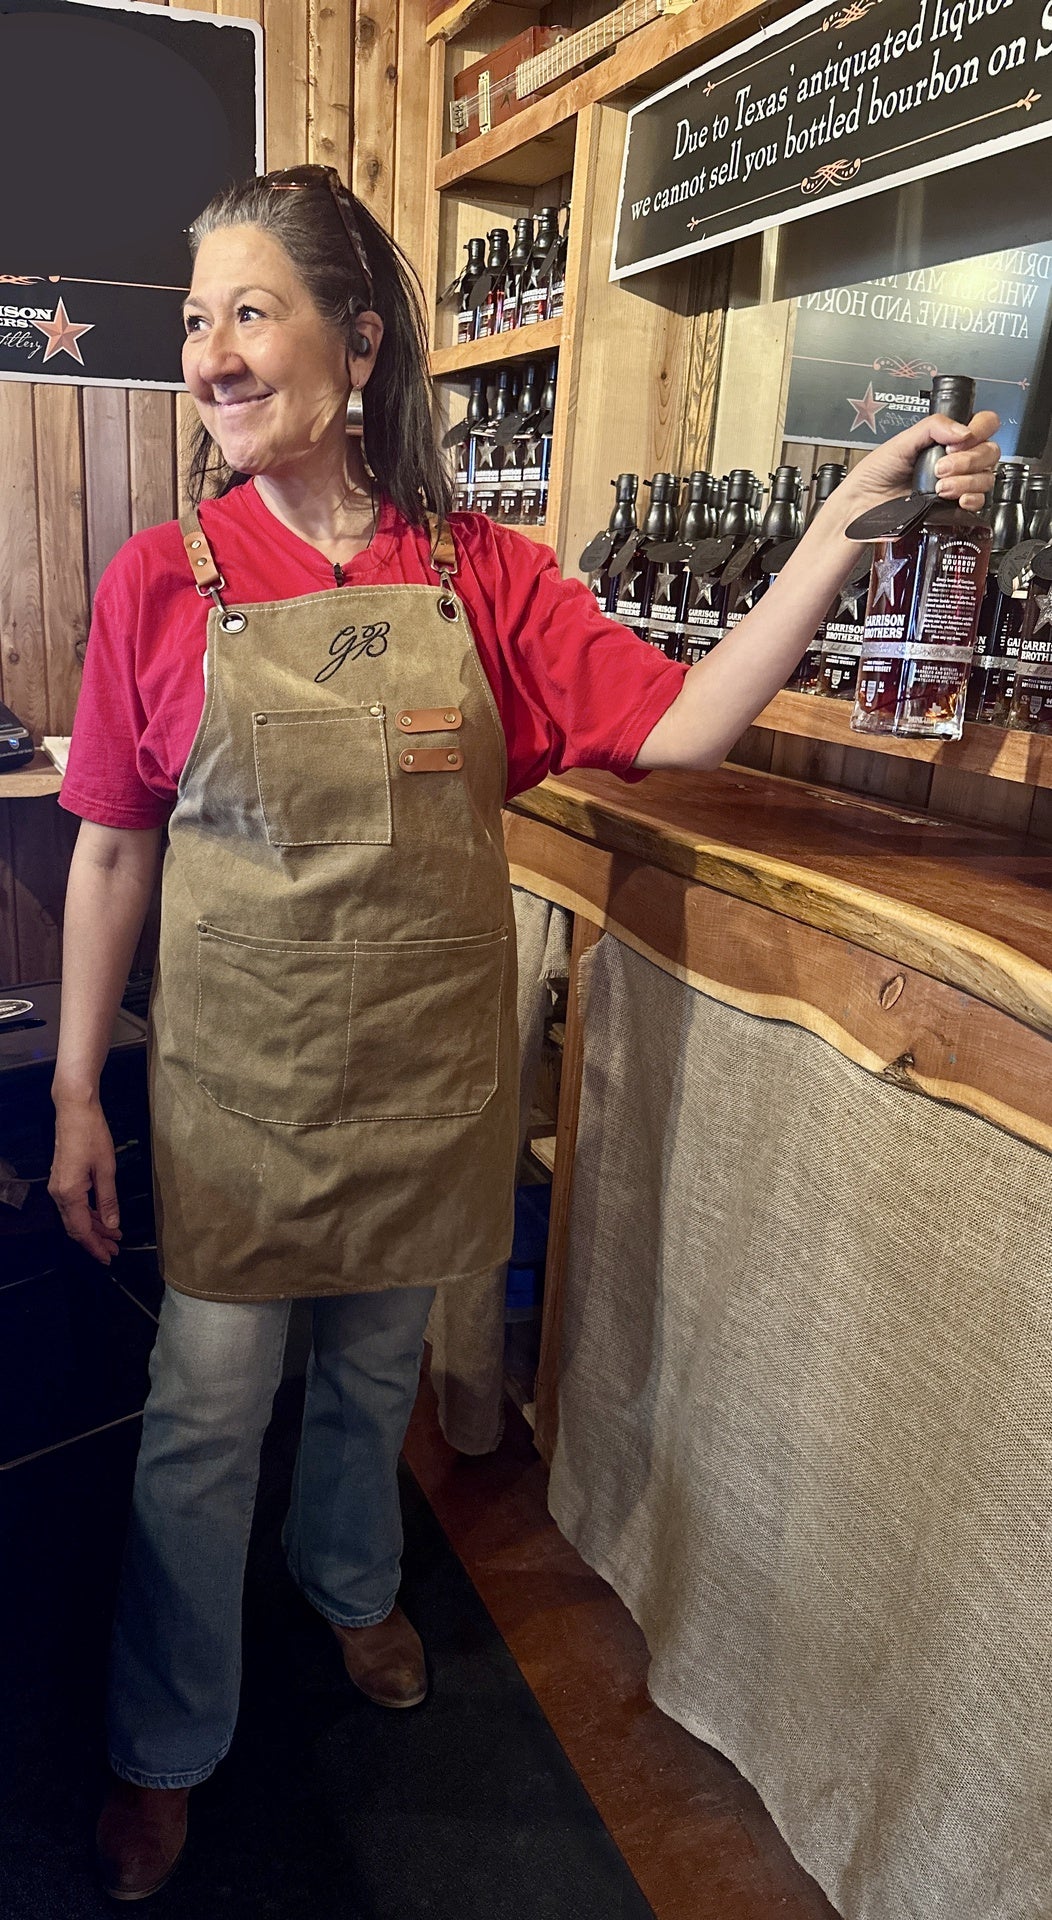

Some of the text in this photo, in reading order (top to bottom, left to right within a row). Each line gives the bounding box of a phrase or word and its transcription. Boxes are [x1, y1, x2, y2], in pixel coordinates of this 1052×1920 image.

[673, 119, 708, 160] Due
[712, 115, 729, 138] to
[735, 64, 795, 132] Texas'
[797, 0, 927, 103] antiquated
[930, 0, 1013, 42] liquo
[632, 37, 1026, 220] we cannot sell you bottled bourbon on
[942, 558, 976, 567] BOURBON
[942, 565, 974, 574] WHISKEY
[688, 609, 720, 618] GARRISON
[865, 614, 906, 627] GARRISON
[864, 627, 904, 639] BROTHERS
[1022, 641, 1052, 652] GARRI
[1021, 650, 1052, 662] BROTH
